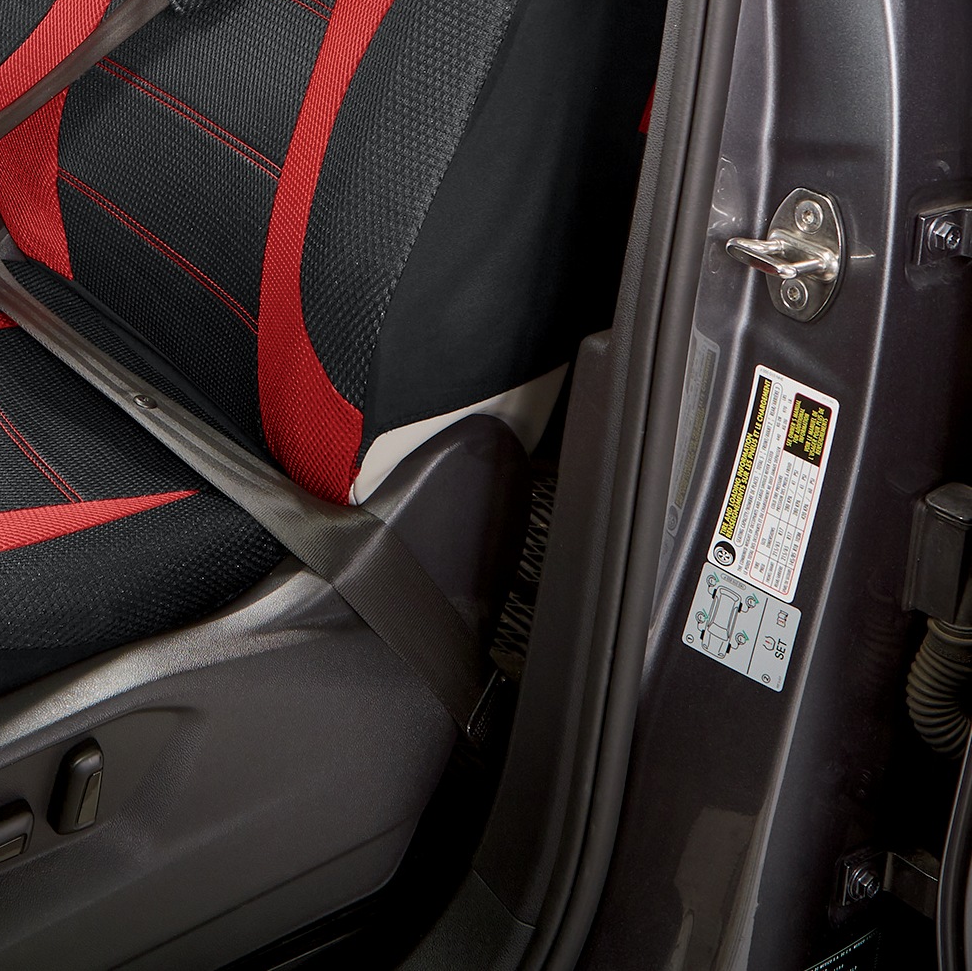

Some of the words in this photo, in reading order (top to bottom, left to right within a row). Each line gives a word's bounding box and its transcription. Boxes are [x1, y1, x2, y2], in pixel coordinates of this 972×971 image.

[756, 378, 771, 422] CHARGEMENT
[792, 398, 800, 418] MANUAL
[754, 421, 761, 430] LE
[795, 407, 804, 434] ADDITIONAL
[798, 412, 809, 443] INFORMATION
[807, 416, 815, 436] MANUEL
[752, 429, 759, 438] ET
[736, 432, 752, 477] INFORMATION
[747, 437, 757, 459] PNEUS
[741, 470, 749, 484] SUR
[728, 476, 741, 506] LOADING
[723, 505, 733, 522] AND
[725, 483, 746, 538] RENSEIGNEMENTS
[720, 521, 728, 535] TIRE
[736, 528, 744, 543] SEATING
[775, 639, 787, 660] SET
